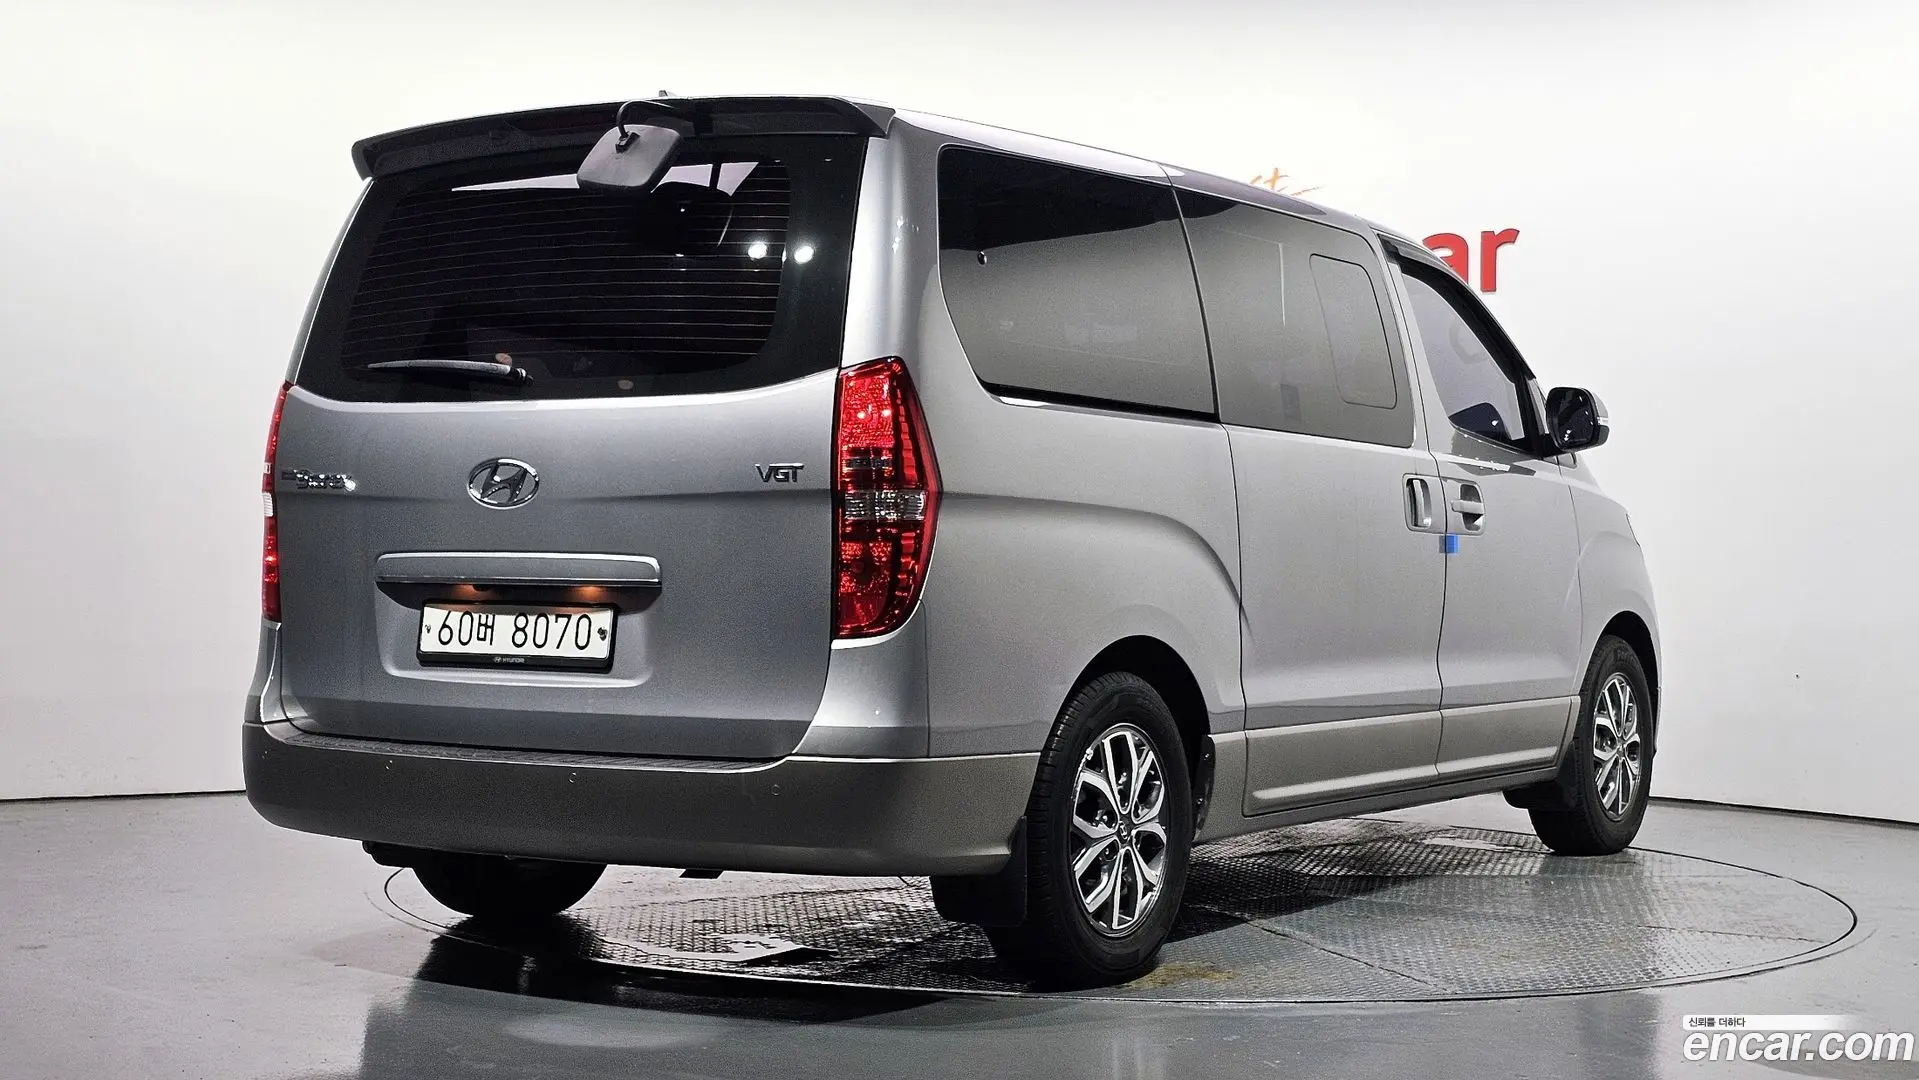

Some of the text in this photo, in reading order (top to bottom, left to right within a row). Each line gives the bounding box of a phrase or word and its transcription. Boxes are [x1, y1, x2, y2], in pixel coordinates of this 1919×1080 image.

[754, 462, 804, 483] VGT
[438, 610, 592, 651] 60버 8070
